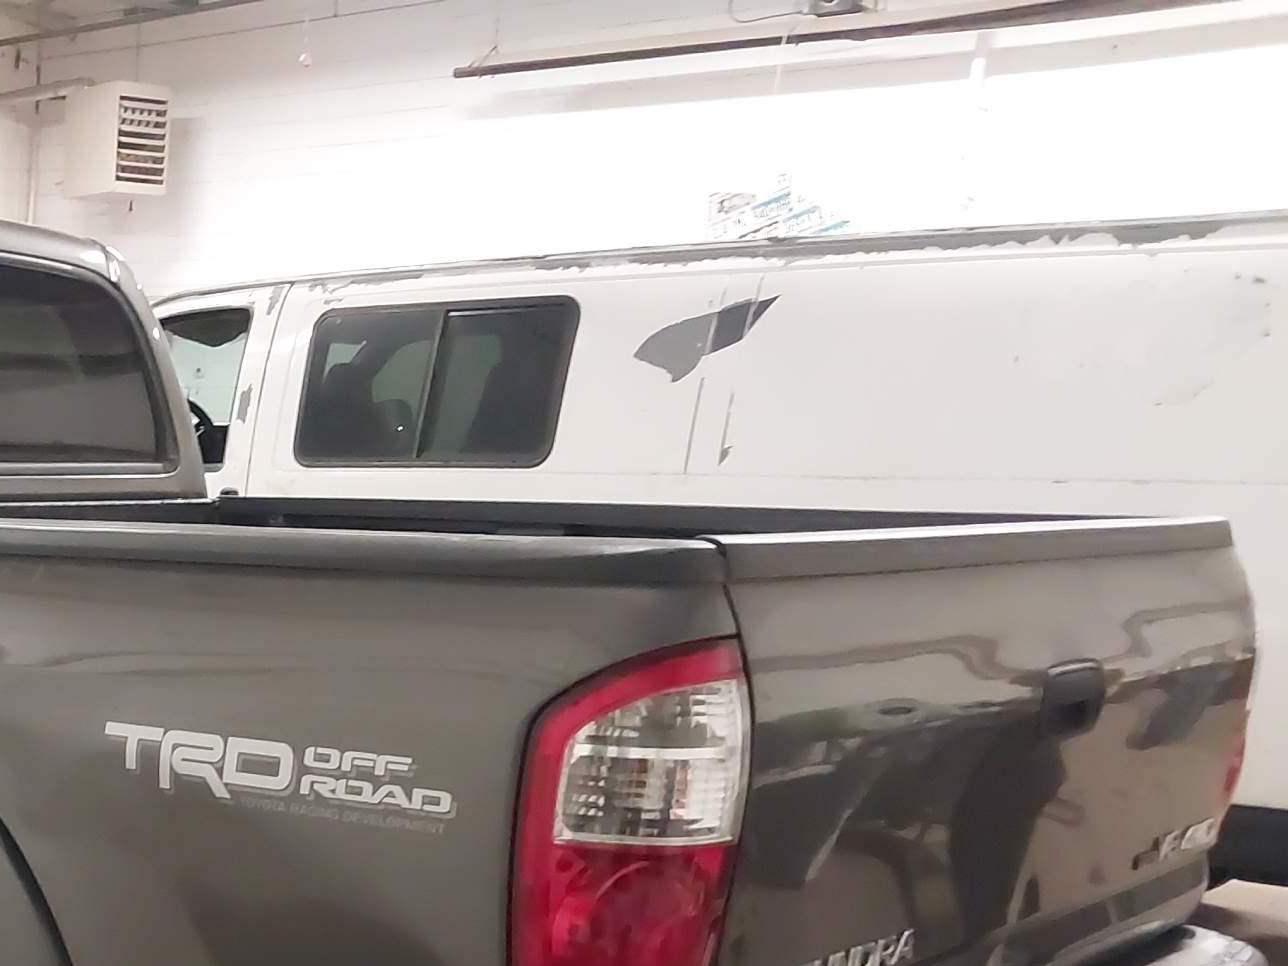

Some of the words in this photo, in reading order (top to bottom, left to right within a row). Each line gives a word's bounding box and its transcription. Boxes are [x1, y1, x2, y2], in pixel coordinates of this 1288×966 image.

[104, 720, 295, 800] TRD
[302, 745, 415, 777] OFF
[298, 773, 454, 814] ROAD
